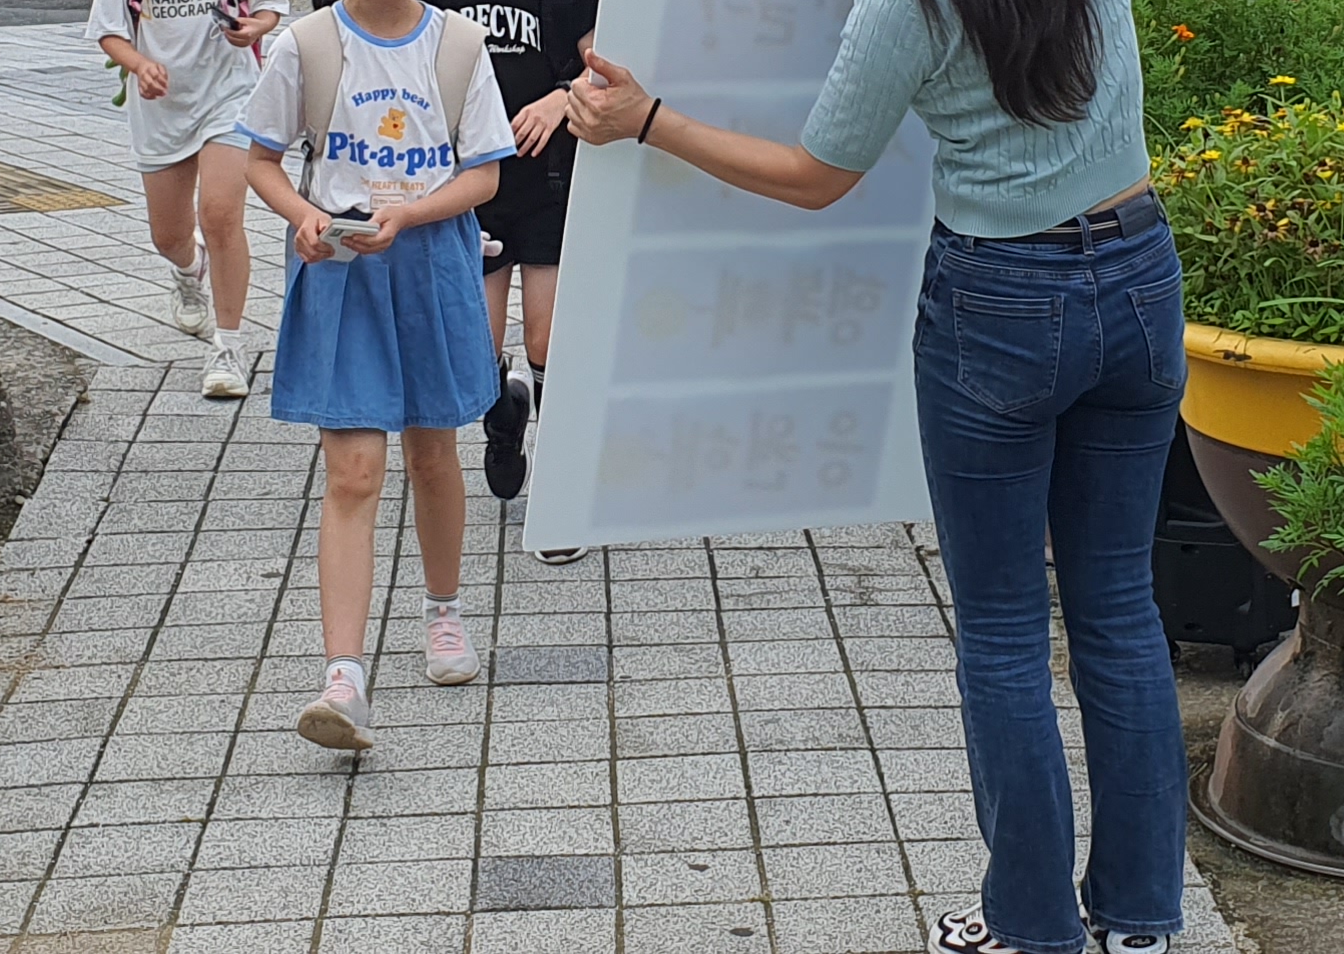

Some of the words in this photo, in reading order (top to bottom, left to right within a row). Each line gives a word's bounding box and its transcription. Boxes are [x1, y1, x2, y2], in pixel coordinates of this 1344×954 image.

[351, 88, 398, 107] Happy
[401, 88, 431, 110] bear
[327, 132, 452, 176] Pit-a-pat
